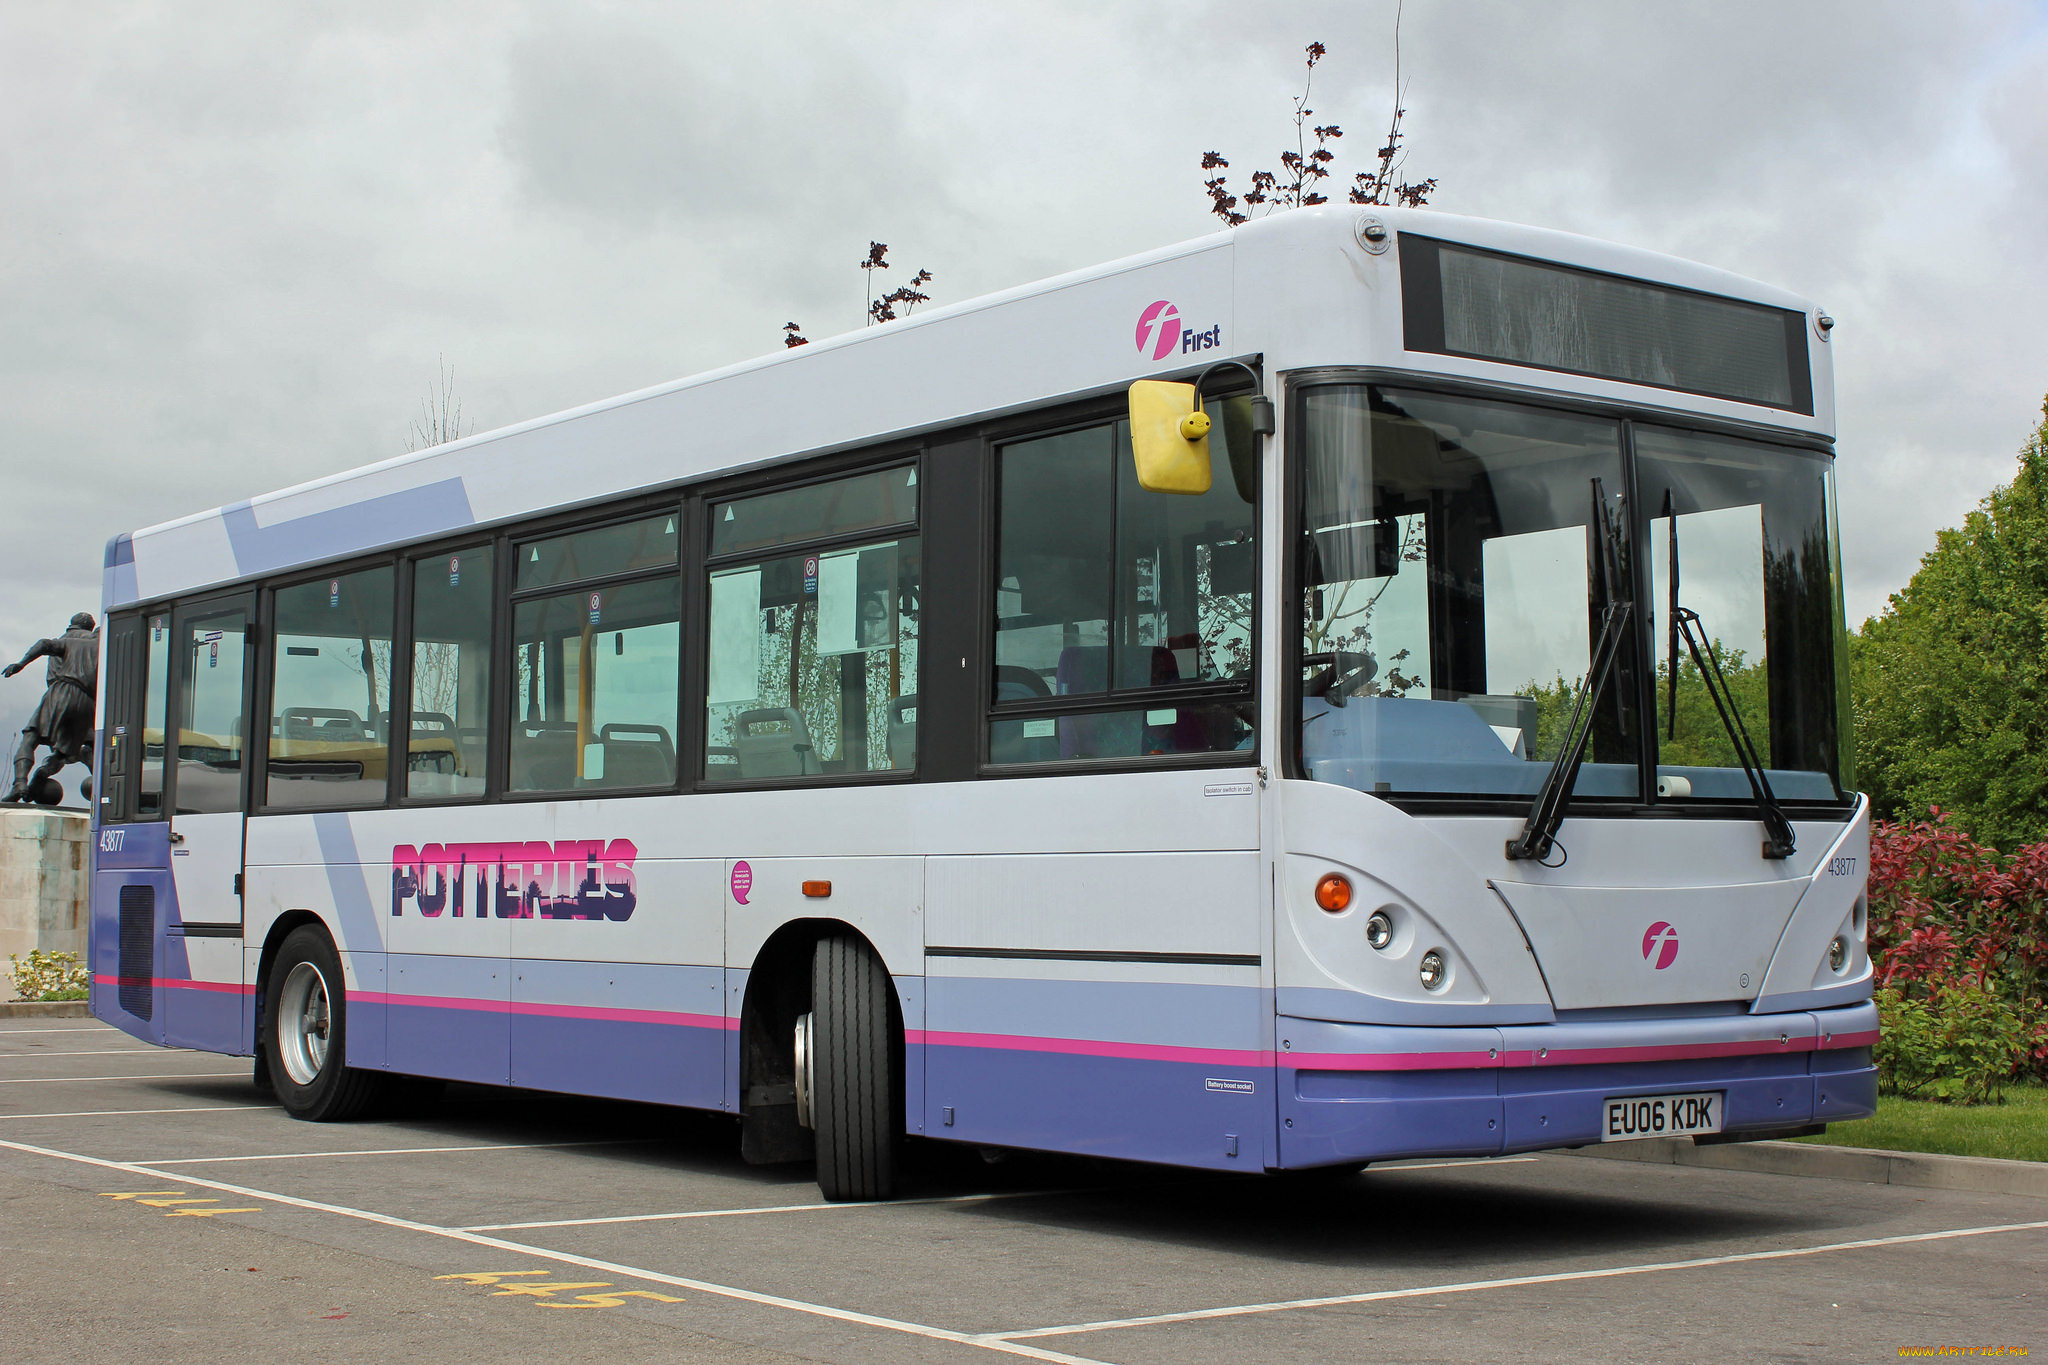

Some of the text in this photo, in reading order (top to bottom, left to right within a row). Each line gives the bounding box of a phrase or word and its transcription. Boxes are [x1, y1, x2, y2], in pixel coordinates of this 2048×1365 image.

[1183, 324, 1220, 354] First
[100, 830, 125, 851] 43877
[1828, 857, 1856, 876] 43877
[392, 838, 638, 921] POTTERIES
[1207, 1080, 1223, 1089] Battery
[1223, 1081, 1237, 1089] boost
[1609, 1097, 1713, 1136] EU06 KDK
